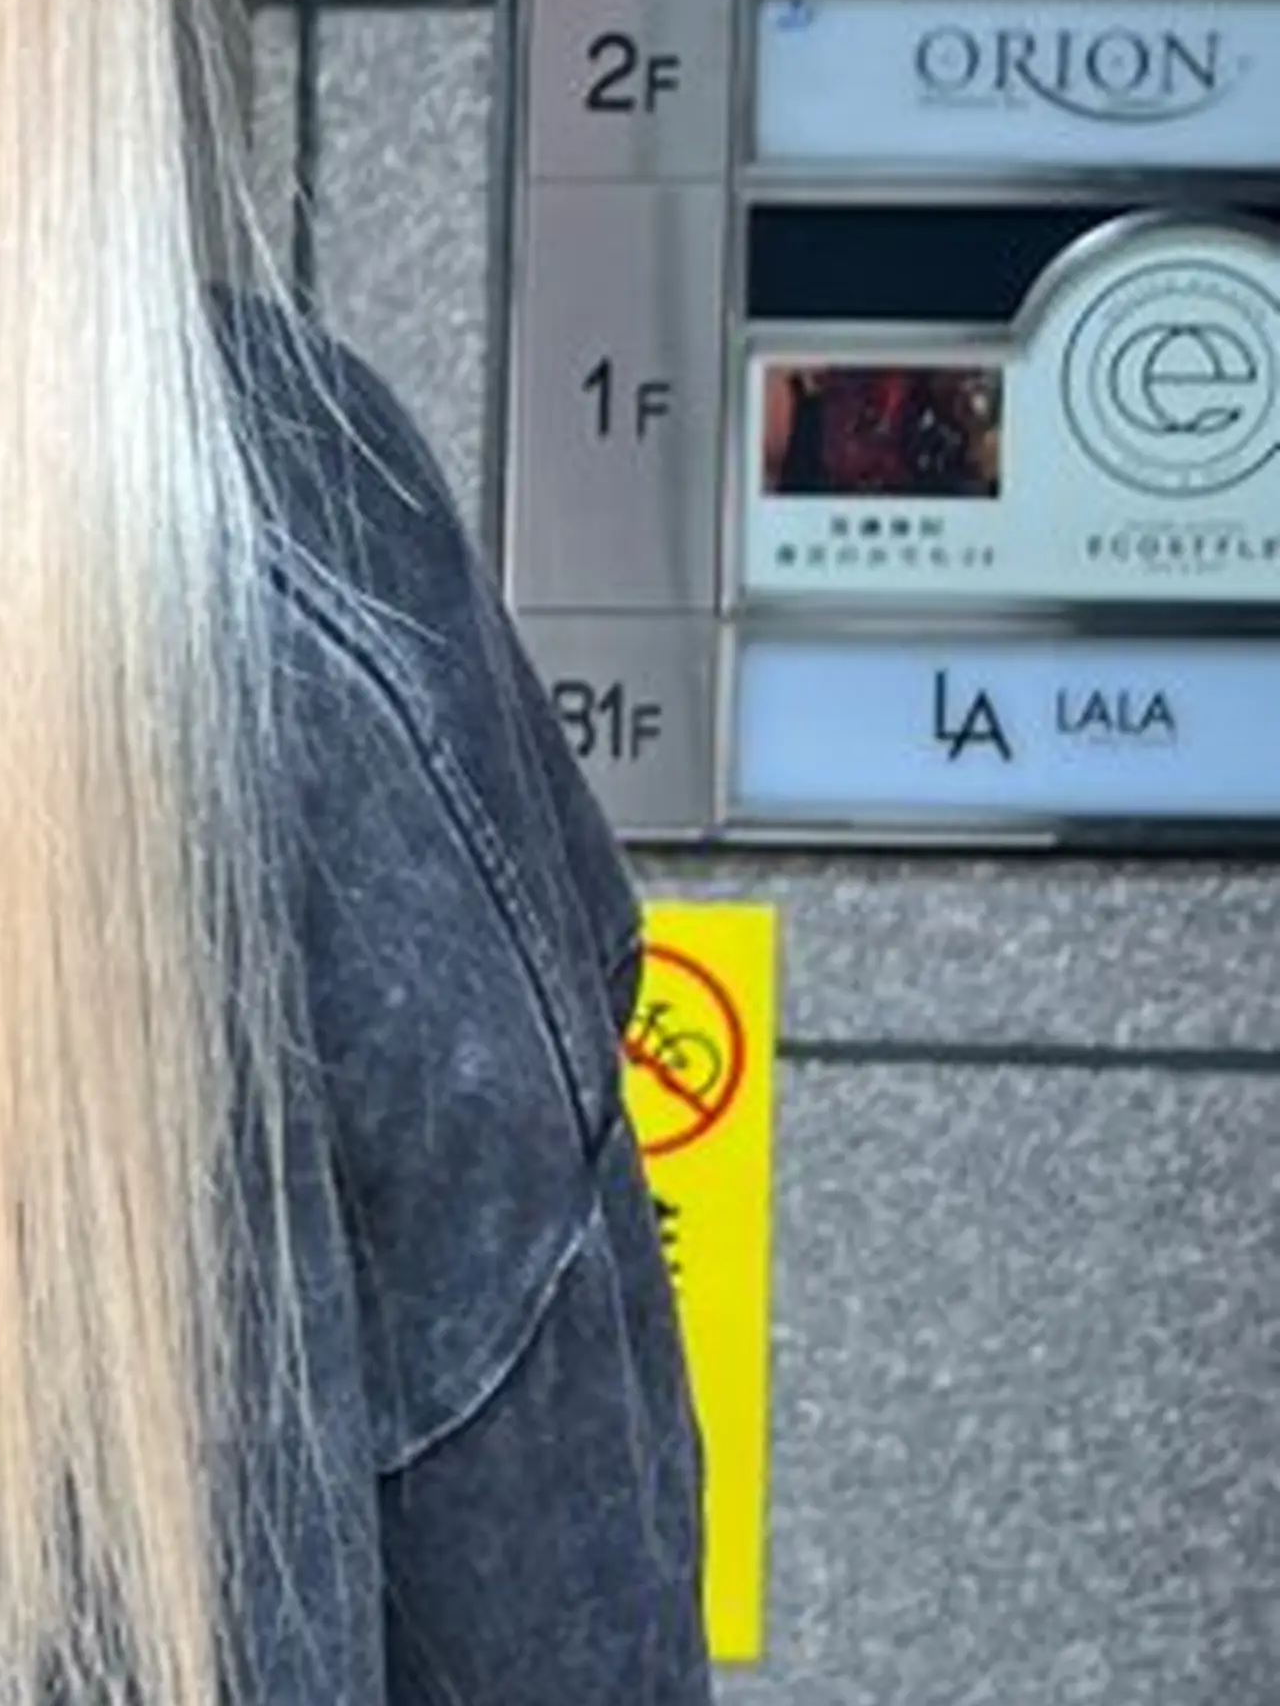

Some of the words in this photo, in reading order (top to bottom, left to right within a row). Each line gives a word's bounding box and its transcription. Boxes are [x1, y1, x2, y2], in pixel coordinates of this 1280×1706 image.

[585, 32, 679, 112] 2F
[914, 24, 1224, 126] ORION
[583, 358, 670, 438] 1F
[1055, 688, 1177, 735] LALA
